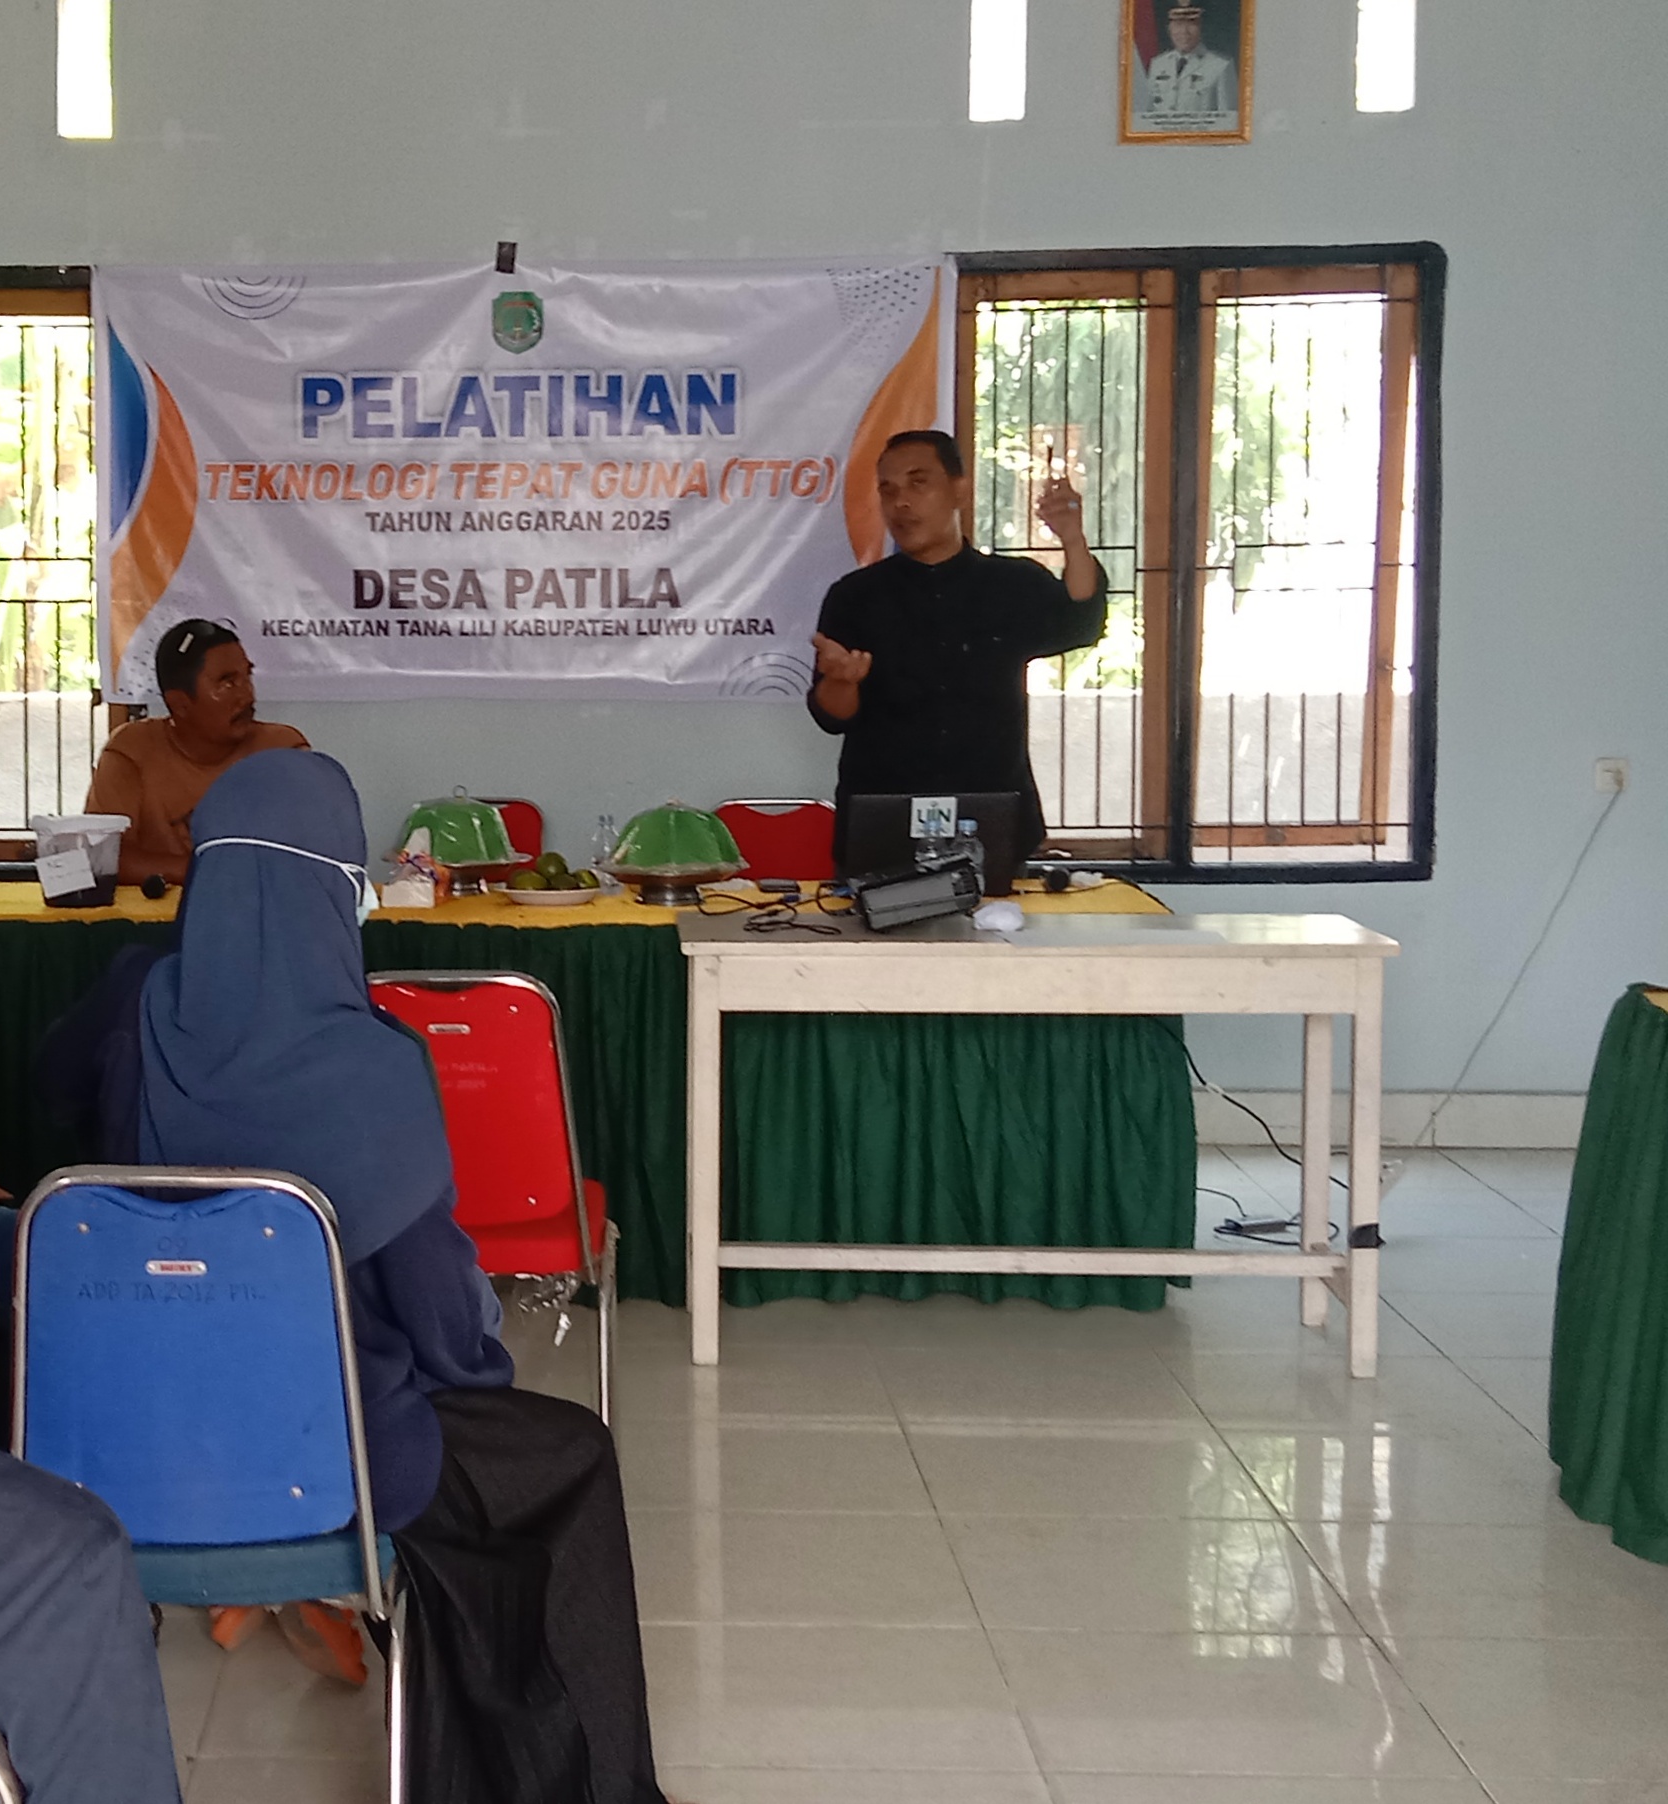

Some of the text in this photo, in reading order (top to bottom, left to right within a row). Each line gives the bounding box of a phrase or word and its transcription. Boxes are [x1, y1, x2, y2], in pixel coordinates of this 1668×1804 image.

[300, 373, 737, 439] PELATIHAN
[204, 456, 837, 504] TEKNOLOGI TEPAT GUNA (TTG)
[365, 510, 671, 532] TAHUN ANGGARAN 2025
[352, 567, 682, 610] DESA PATILA
[261, 617, 776, 637] KECAMATAN TANA LILI KABUPATEN LUWU UTARA
